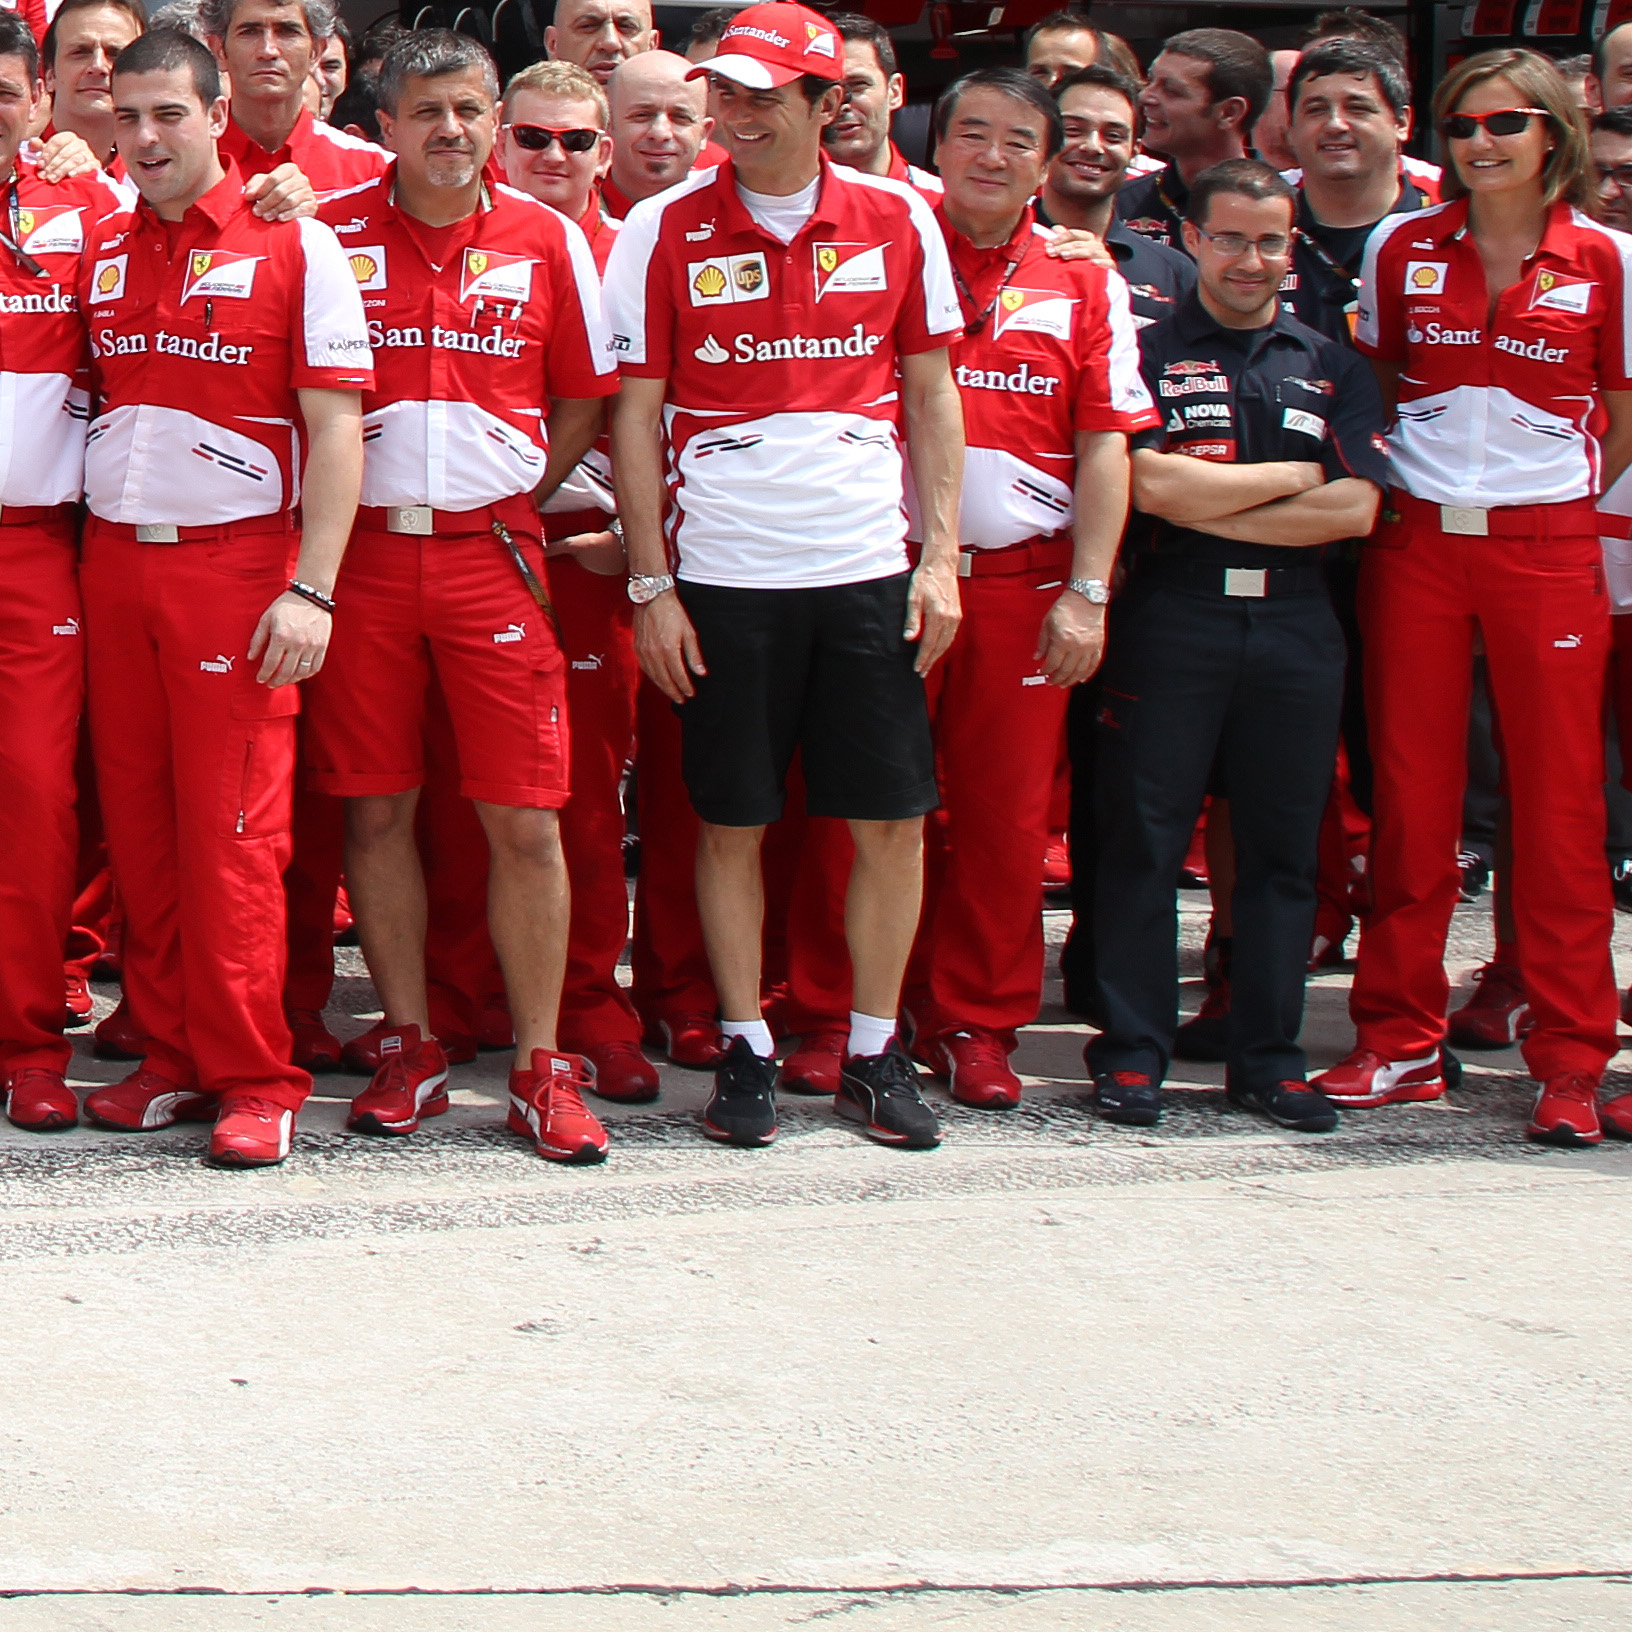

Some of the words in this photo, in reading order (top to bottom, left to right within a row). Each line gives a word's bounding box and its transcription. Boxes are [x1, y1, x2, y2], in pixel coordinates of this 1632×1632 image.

[726, 24, 791, 49] Santander
[736, 268, 762, 287] ups
[100, 329, 253, 365] Santander
[367, 320, 526, 358] Santander
[1425, 323, 1570, 364] Santander
[956, 363, 1060, 396] tander
[1159, 378, 1192, 397] Red
[1193, 375, 1231, 393] Bull
[1185, 404, 1232, 418] NOVA
[1188, 444, 1228, 456] CEPSA
